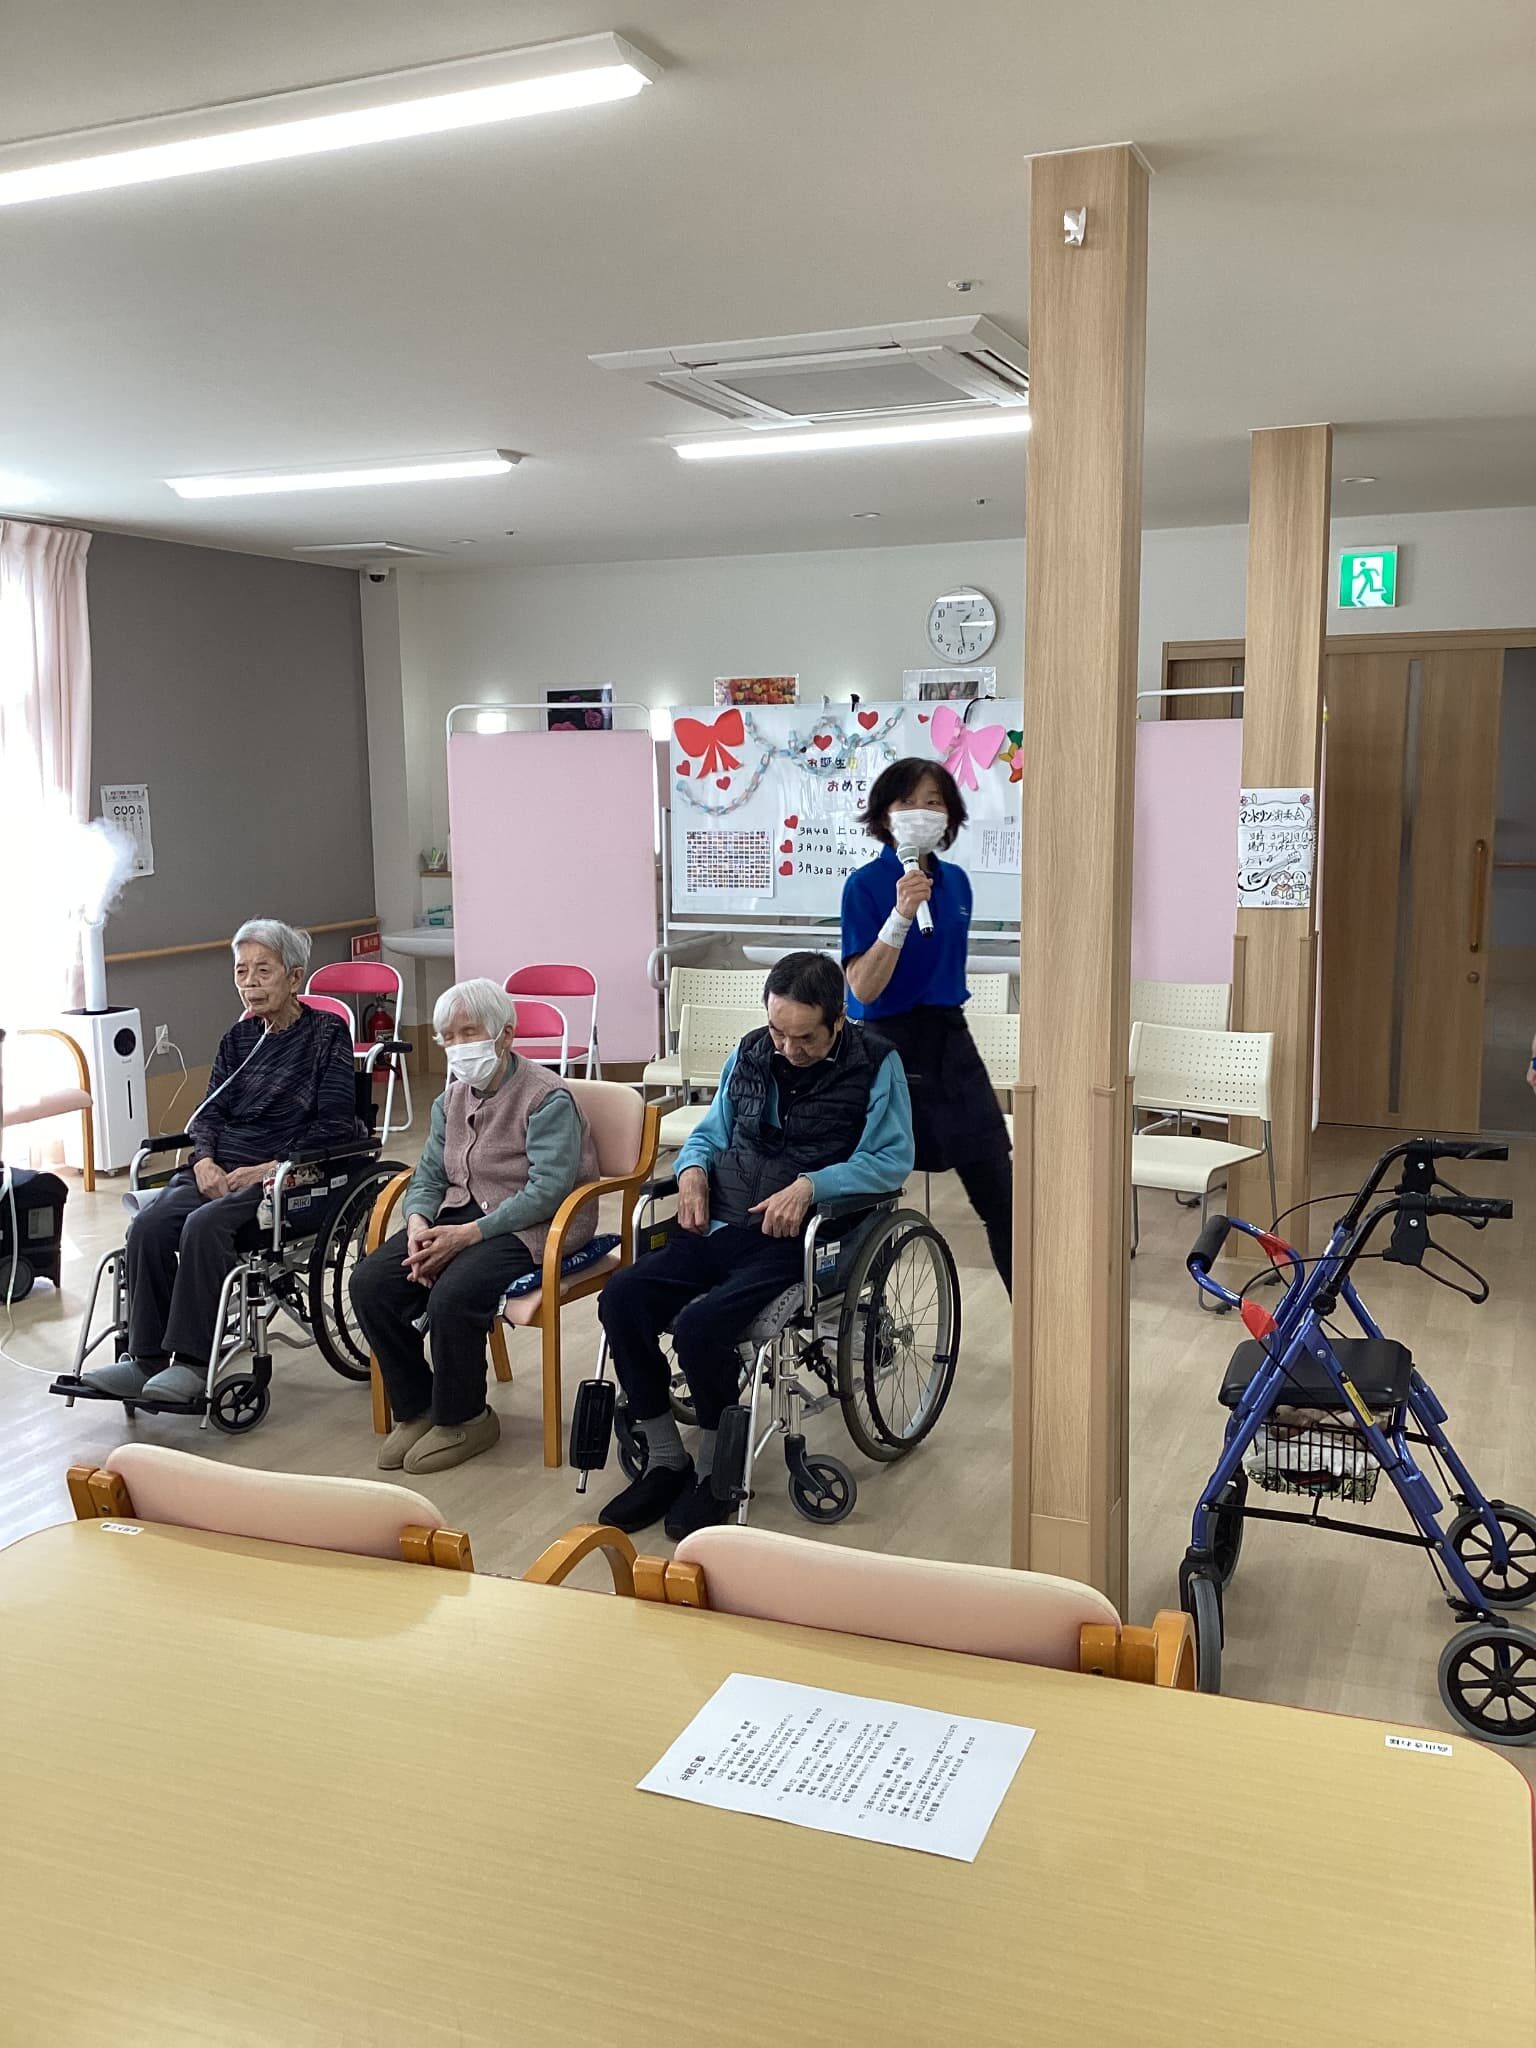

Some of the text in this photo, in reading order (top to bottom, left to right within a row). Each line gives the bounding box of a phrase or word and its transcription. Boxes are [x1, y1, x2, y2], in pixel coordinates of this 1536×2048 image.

[937, 608, 946, 618] 10
[978, 608, 985, 616] 2
[934, 622, 941, 631] 9
[937, 634, 943, 643] 8
[945, 643, 951, 652] 7
[957, 646, 964, 655] 6
[969, 643, 975, 652] 5
[856, 798, 867, 809] と
